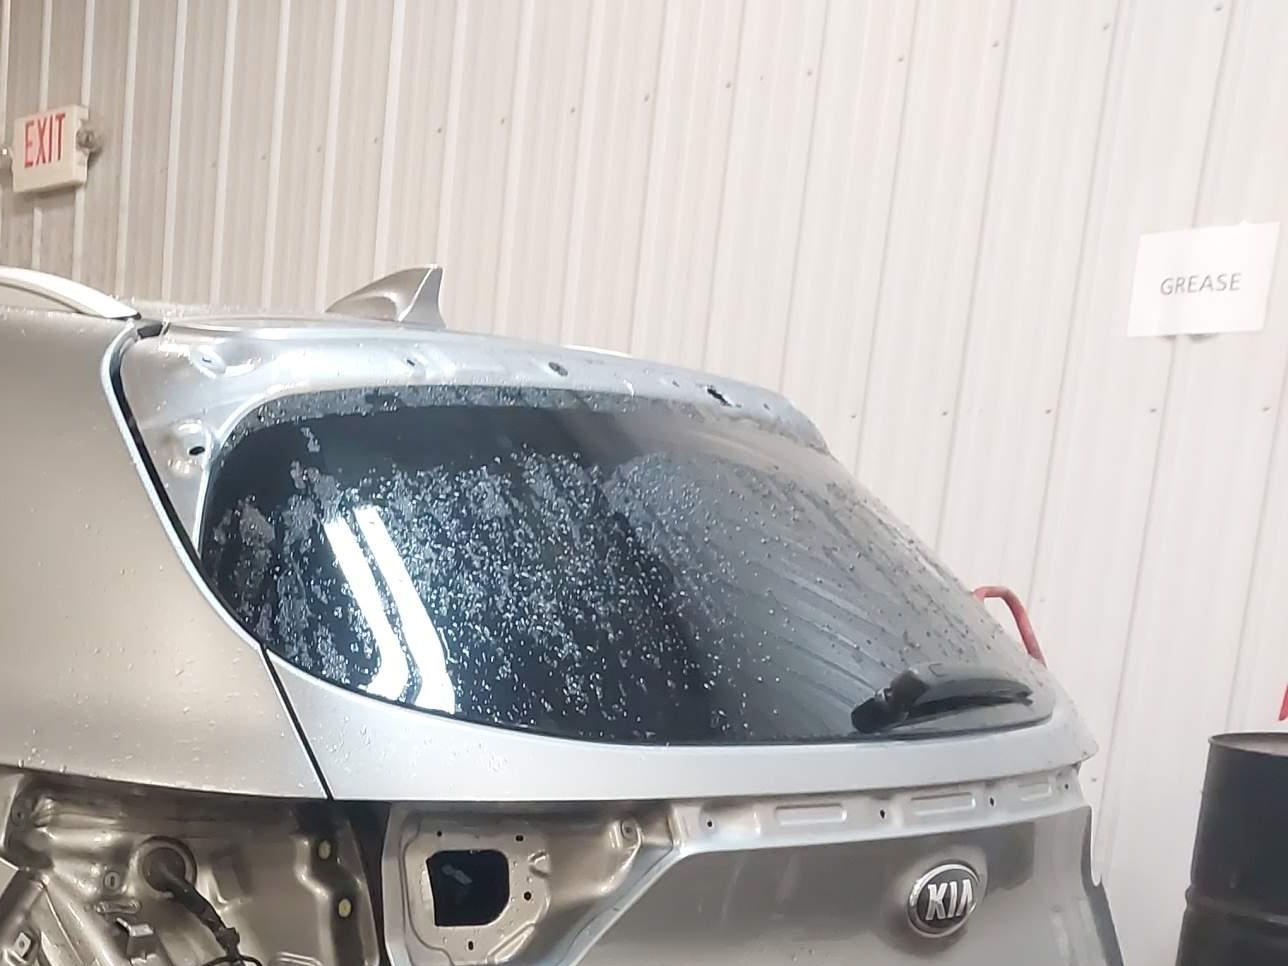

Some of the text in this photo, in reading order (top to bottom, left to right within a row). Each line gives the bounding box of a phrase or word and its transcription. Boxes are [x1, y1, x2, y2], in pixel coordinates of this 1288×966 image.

[24, 113, 66, 168] EXIT
[1159, 273, 1242, 295] GREASE
[925, 878, 973, 921] KIA
